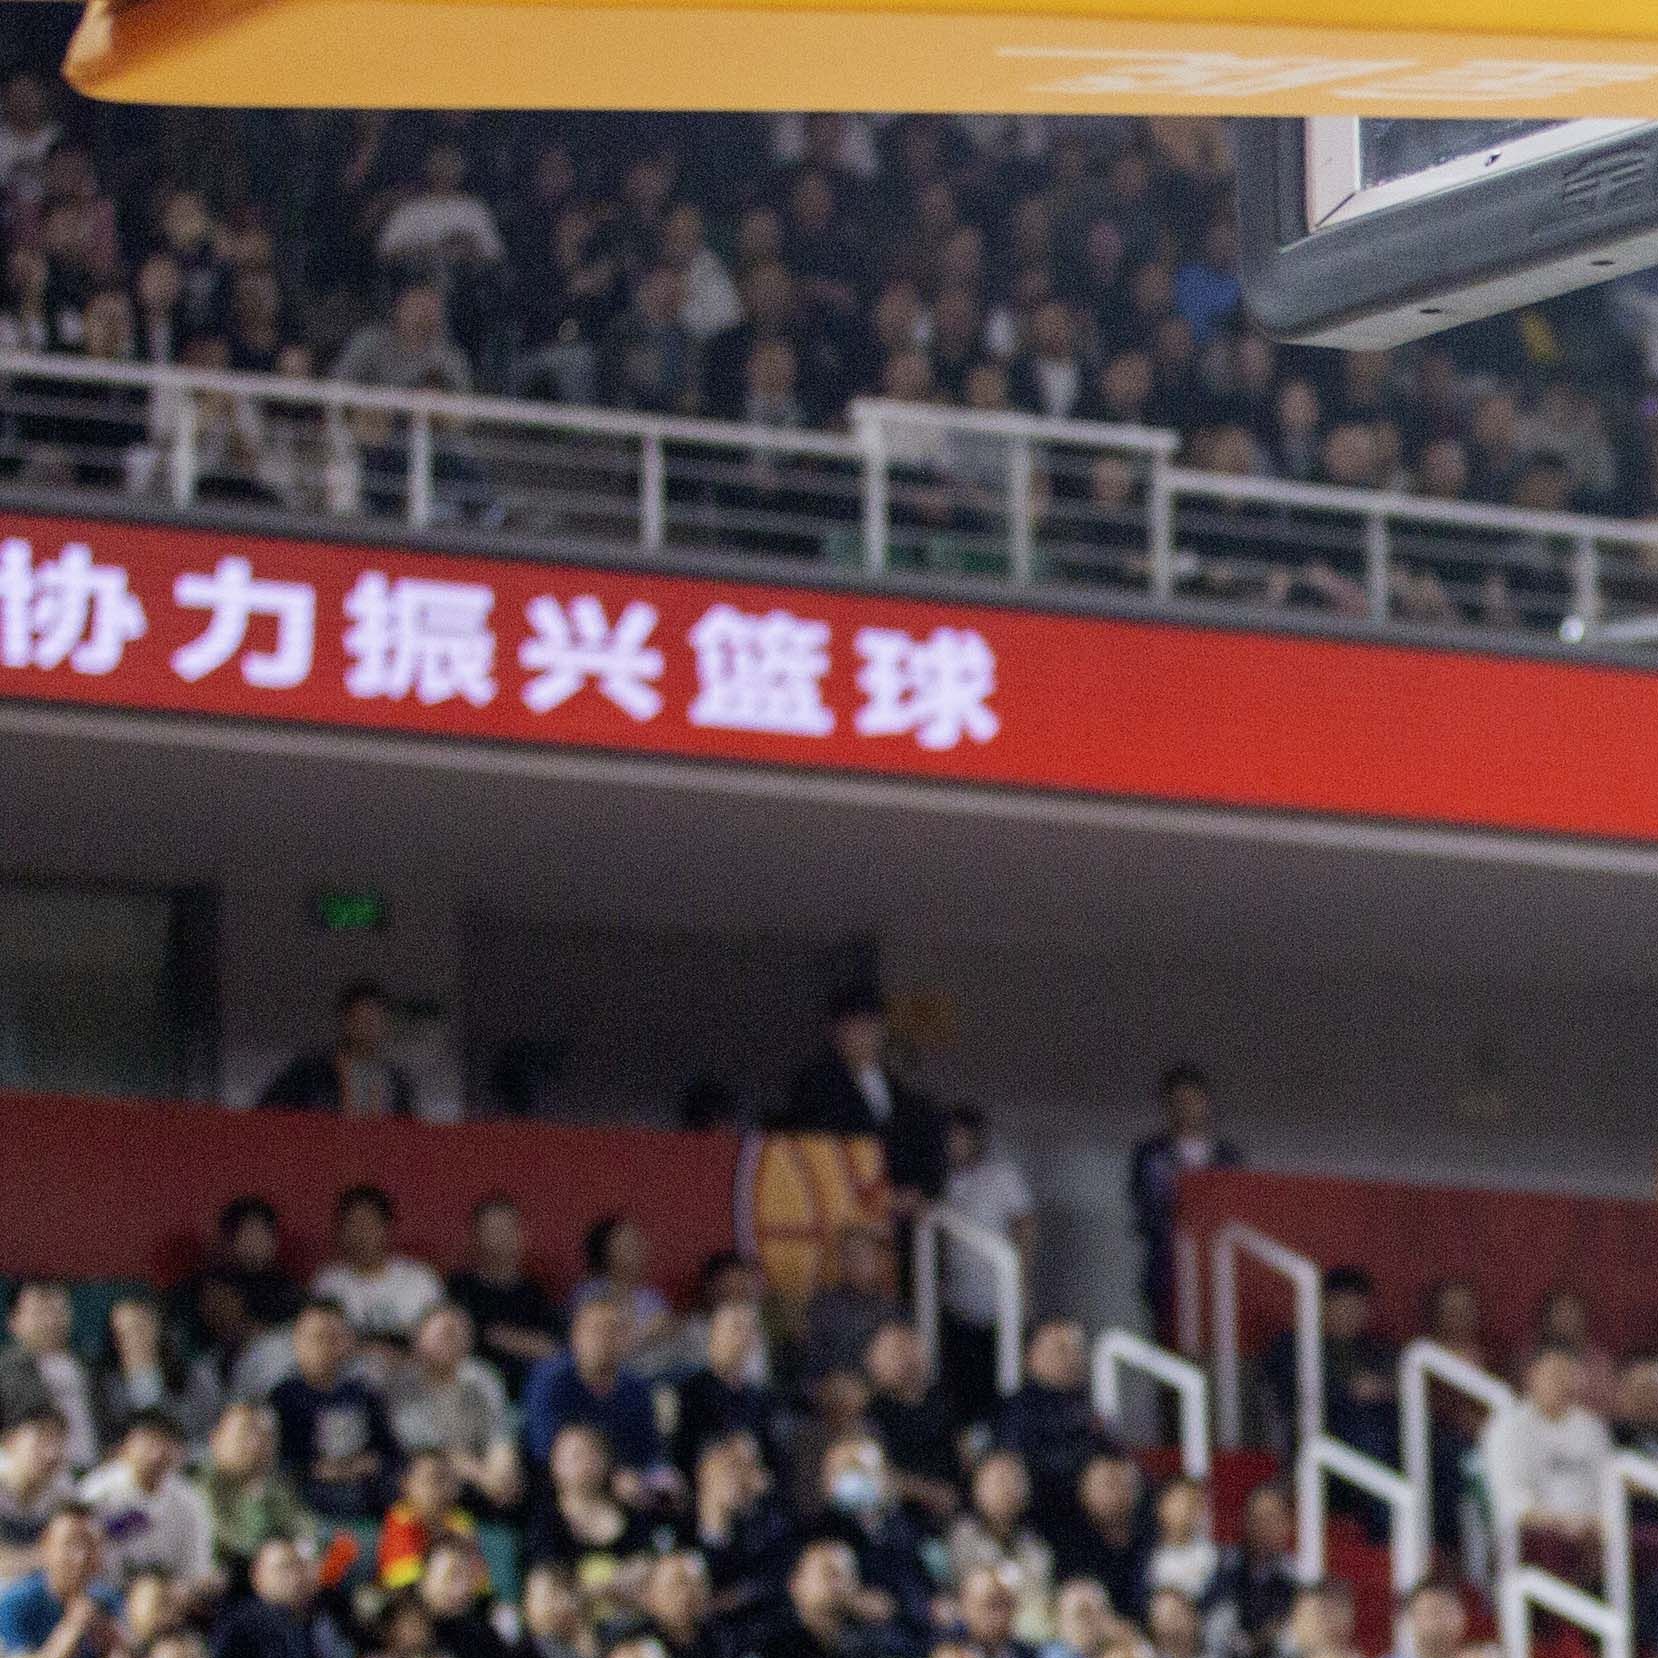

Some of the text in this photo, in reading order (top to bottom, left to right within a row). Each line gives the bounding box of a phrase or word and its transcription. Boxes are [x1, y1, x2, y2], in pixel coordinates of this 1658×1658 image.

[0, 536, 1000, 751] 协力振兴篮球
